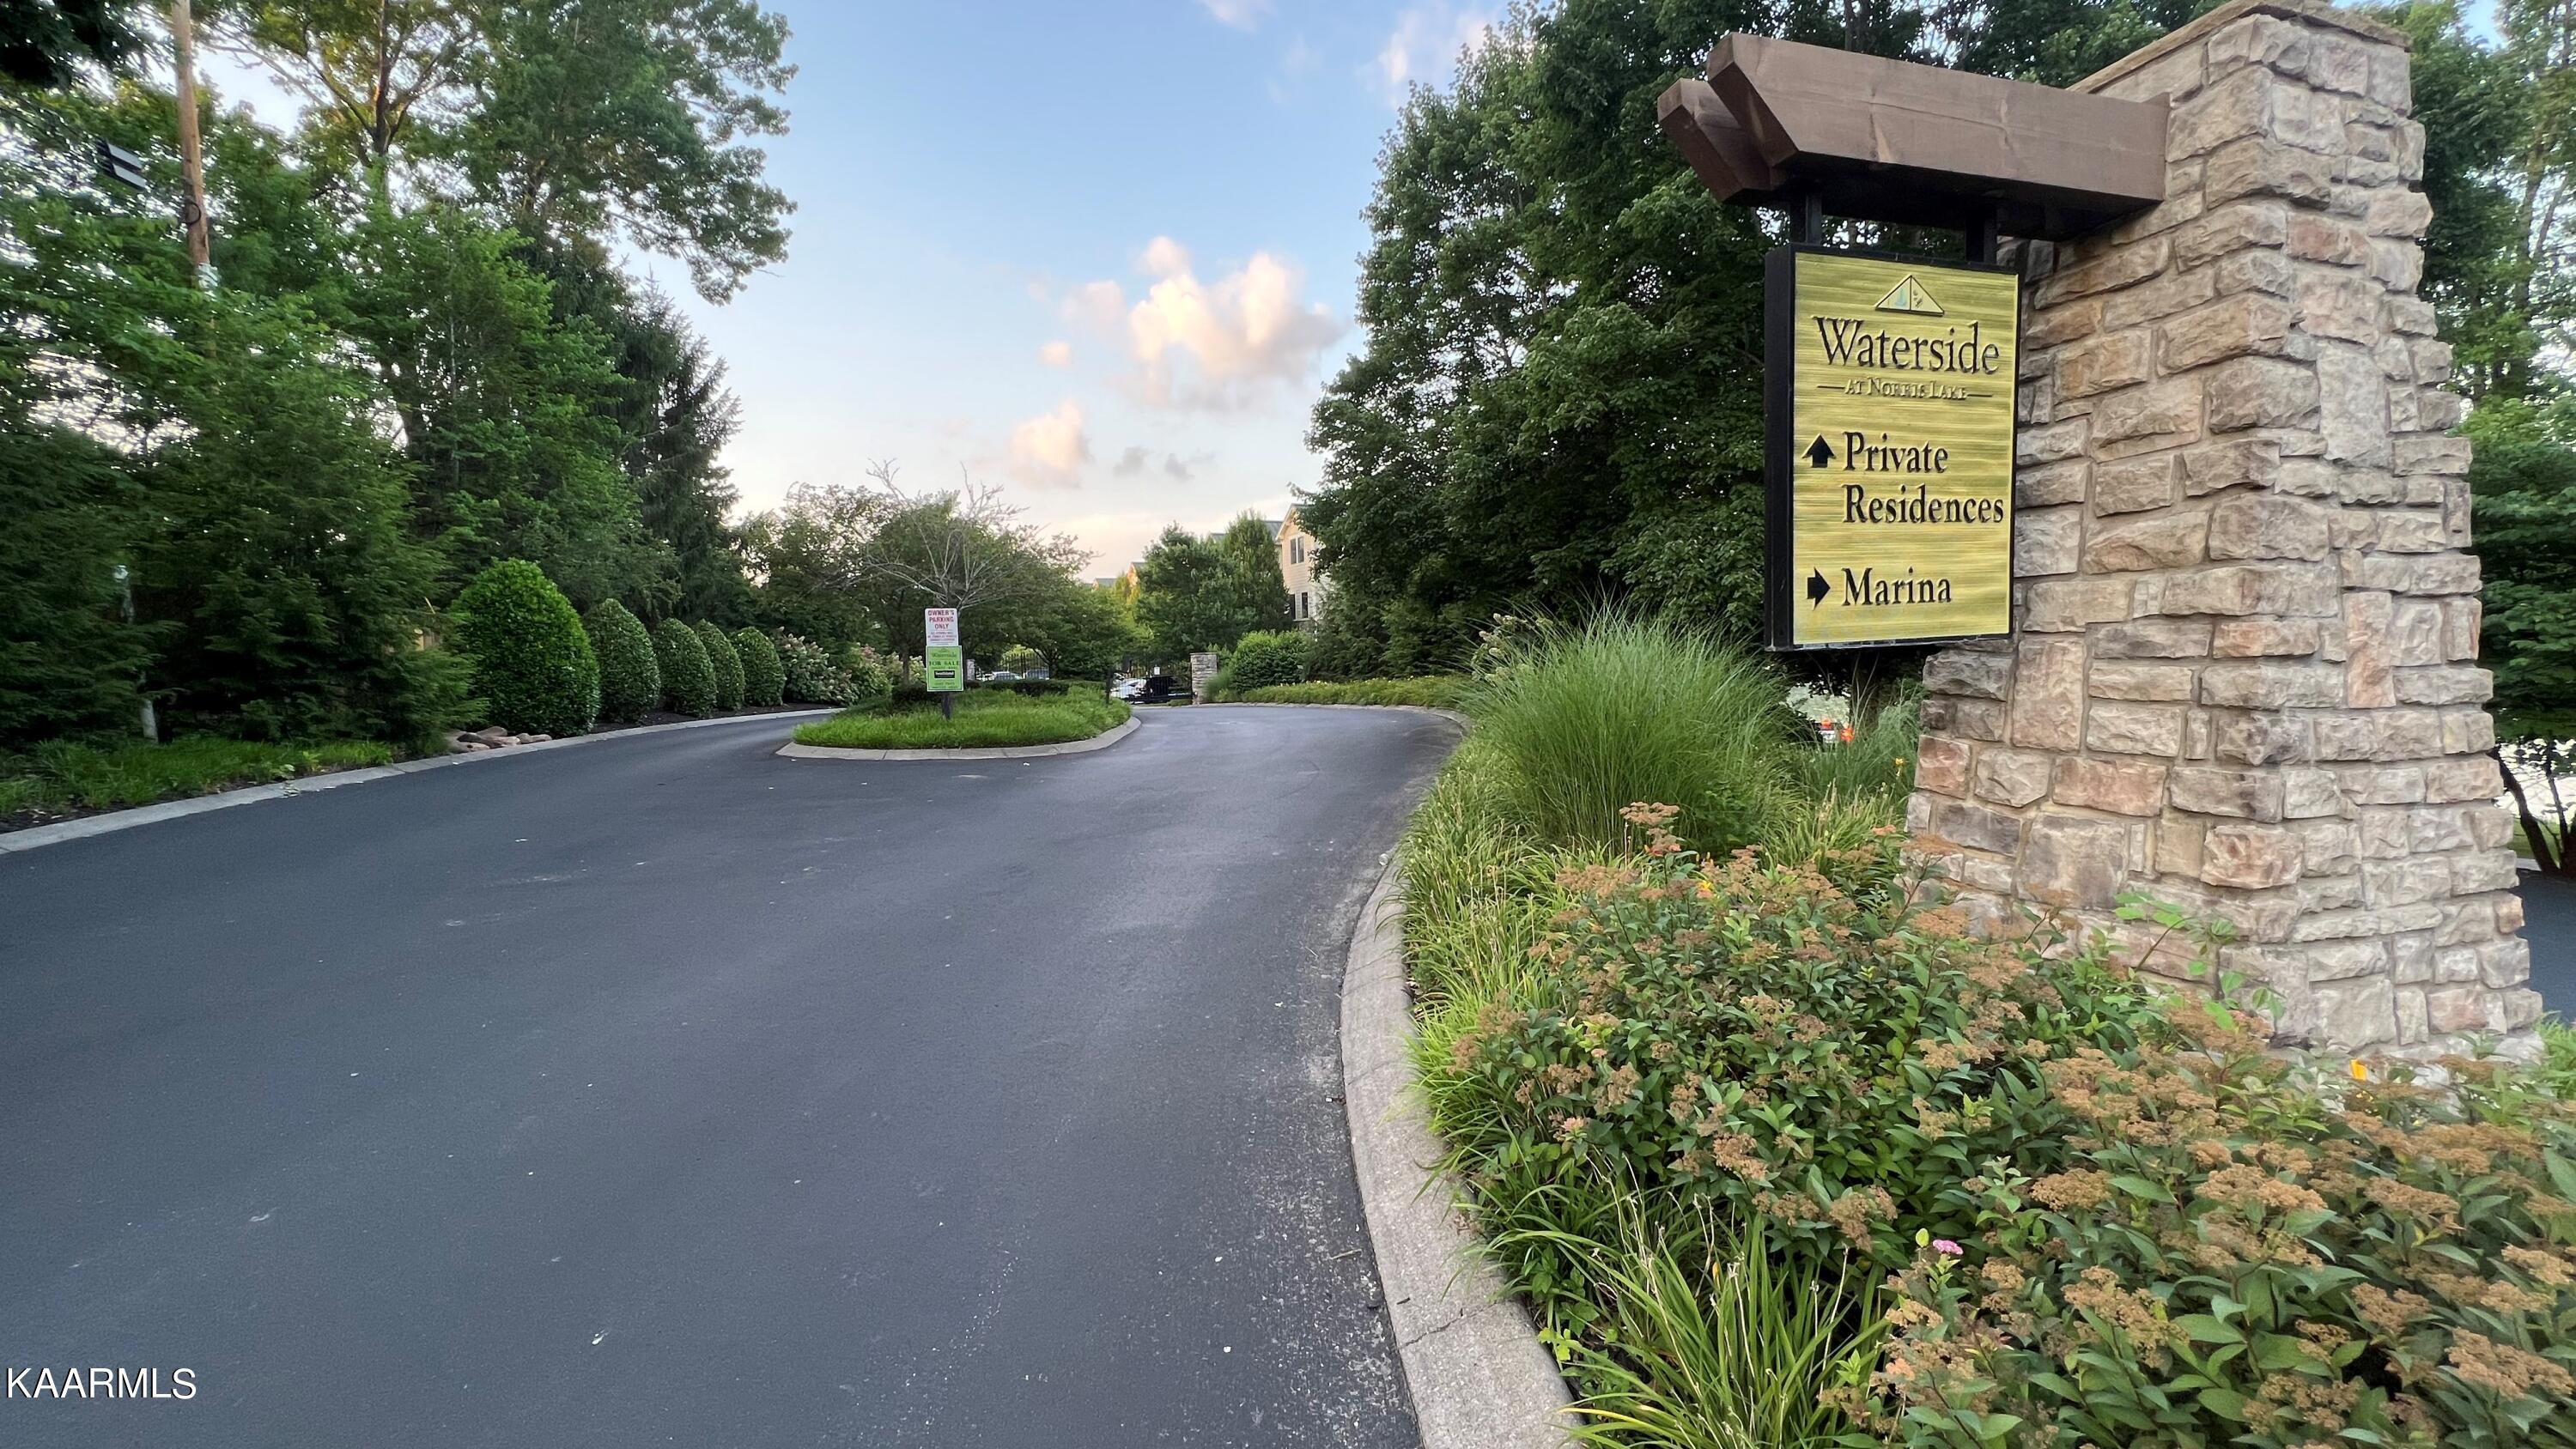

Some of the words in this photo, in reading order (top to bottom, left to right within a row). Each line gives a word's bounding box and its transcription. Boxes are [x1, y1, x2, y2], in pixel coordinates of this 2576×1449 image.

[1811, 315, 1999, 374] Waterside
[1844, 378, 1866, 395] AT
[1928, 380, 1968, 401] LAKE
[1842, 431, 1948, 474] Private
[1841, 482, 2004, 524] Residences
[1841, 566, 1952, 606] Marina
